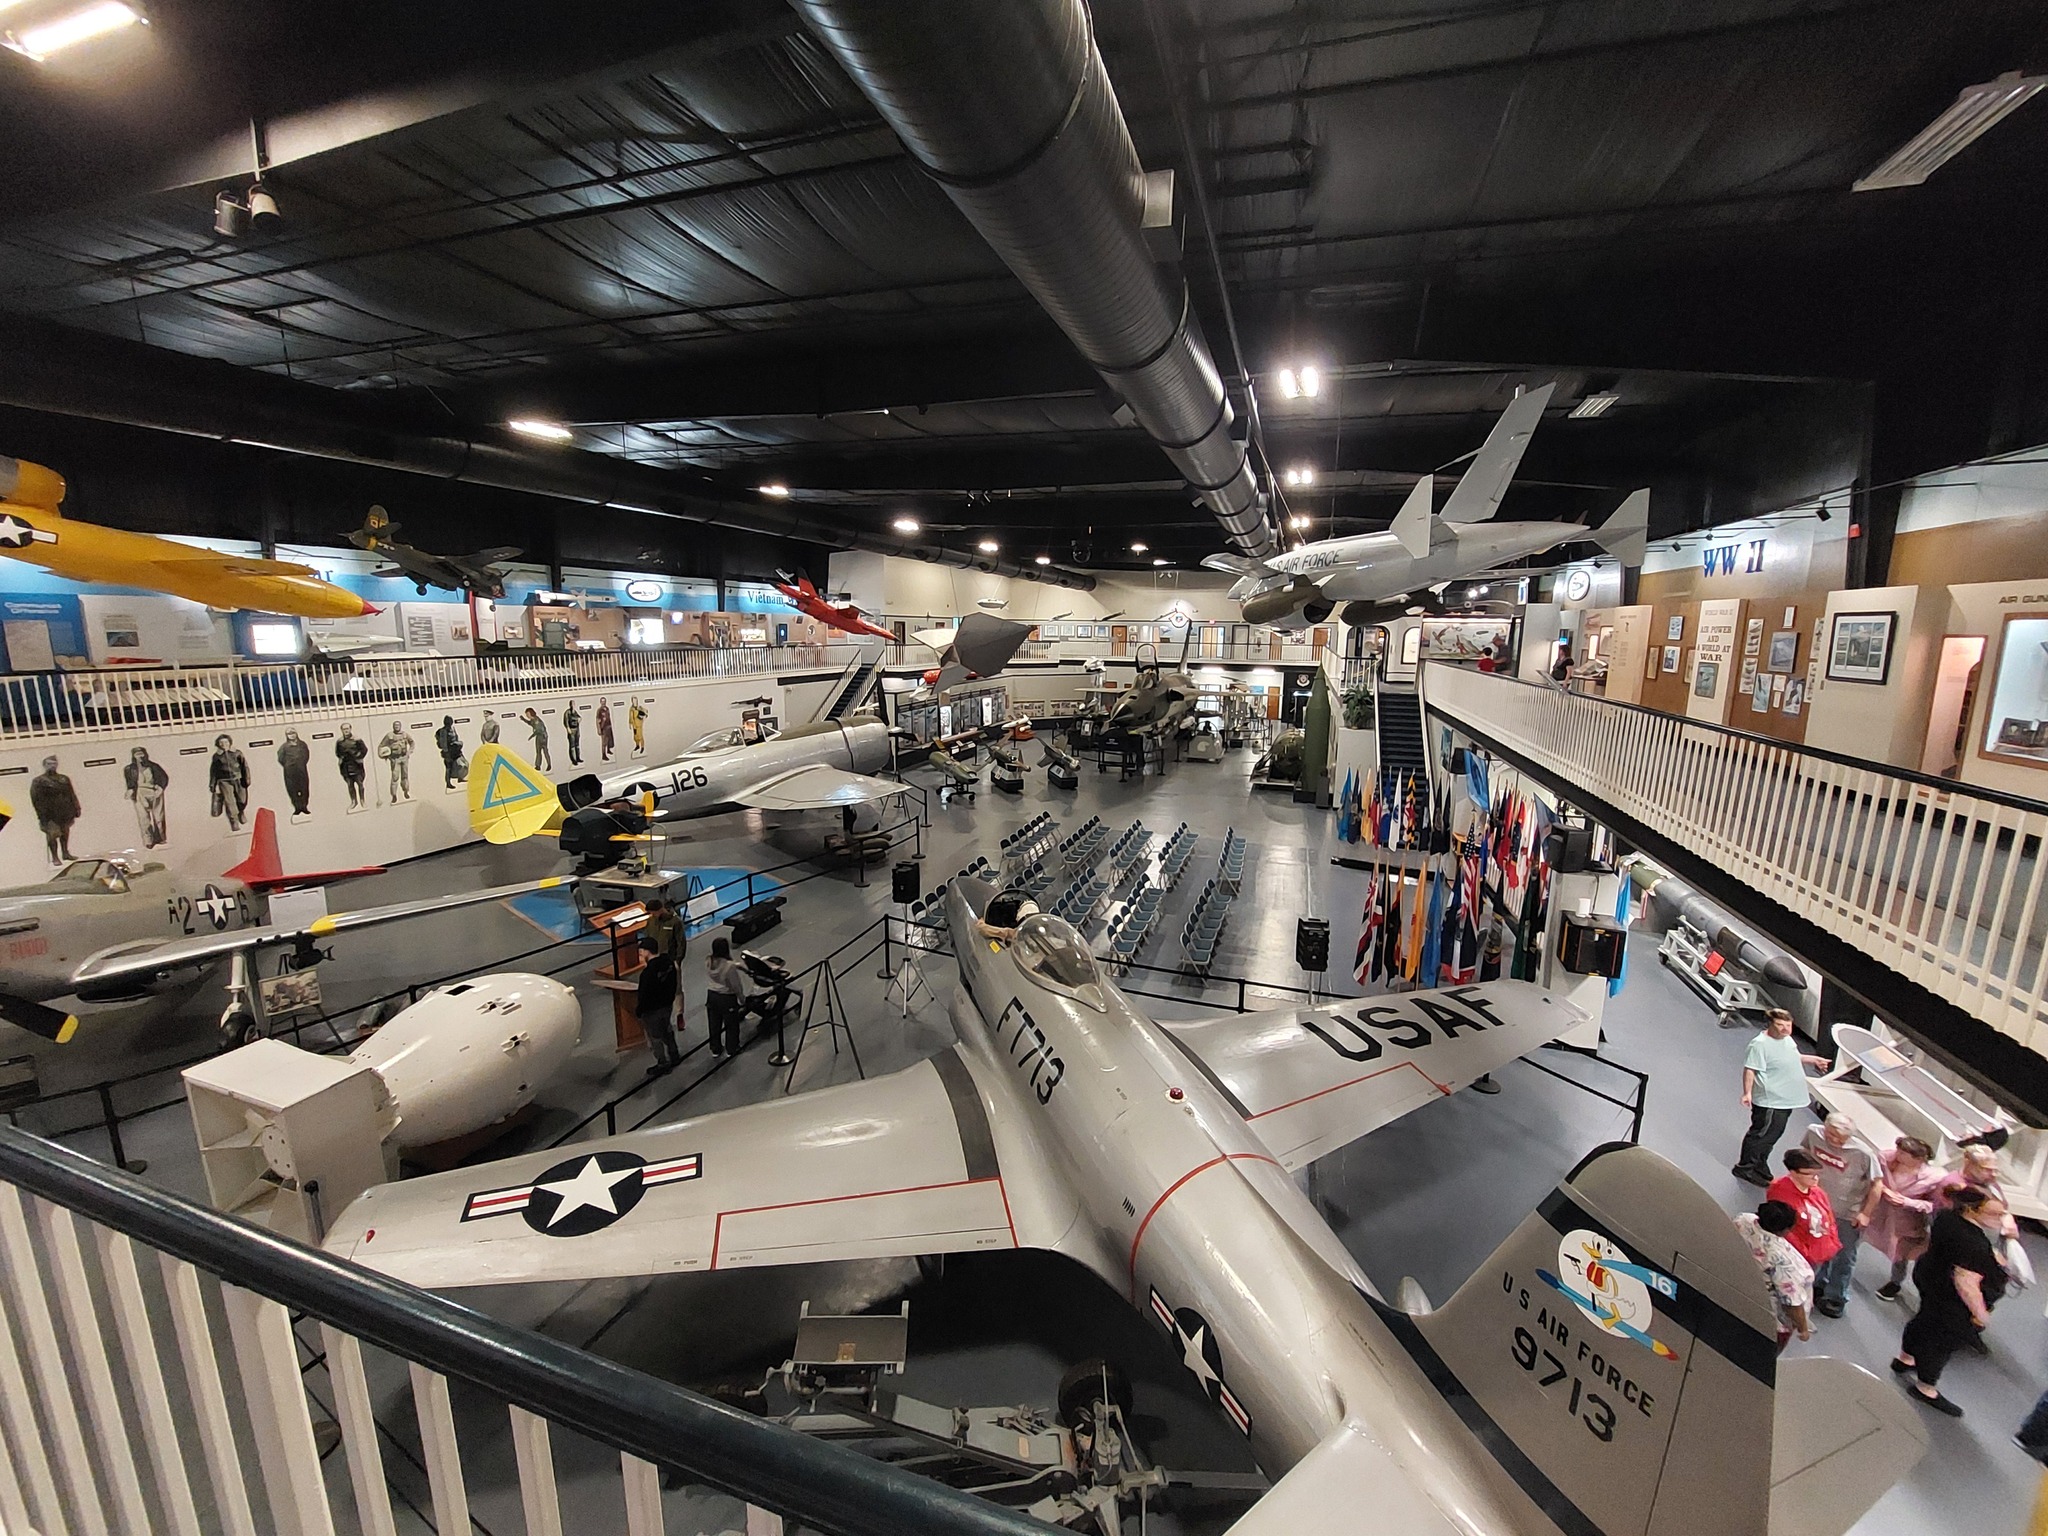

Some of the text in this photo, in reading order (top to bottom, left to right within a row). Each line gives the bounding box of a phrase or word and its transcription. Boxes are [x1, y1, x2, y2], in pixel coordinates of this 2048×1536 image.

[1283, 556, 1300, 573] AIR
[1302, 549, 1344, 570] FORCE
[1703, 539, 1768, 578] WW II
[1998, 596, 2018, 604] AIR
[1707, 635, 1720, 643] AND
[1710, 625, 1732, 634] POWER
[1700, 653, 1723, 662] WAR
[1702, 644, 1721, 652] WORLD
[1721, 645, 1732, 653] AT
[671, 765, 708, 793] 126
[1301, 986, 1506, 1063] USAF
[1648, 1271, 1673, 1296] 16
[1537, 1307, 1570, 1347] AIR
[1576, 1340, 1656, 1418] FORCE
[1511, 1326, 1617, 1443] 9713
